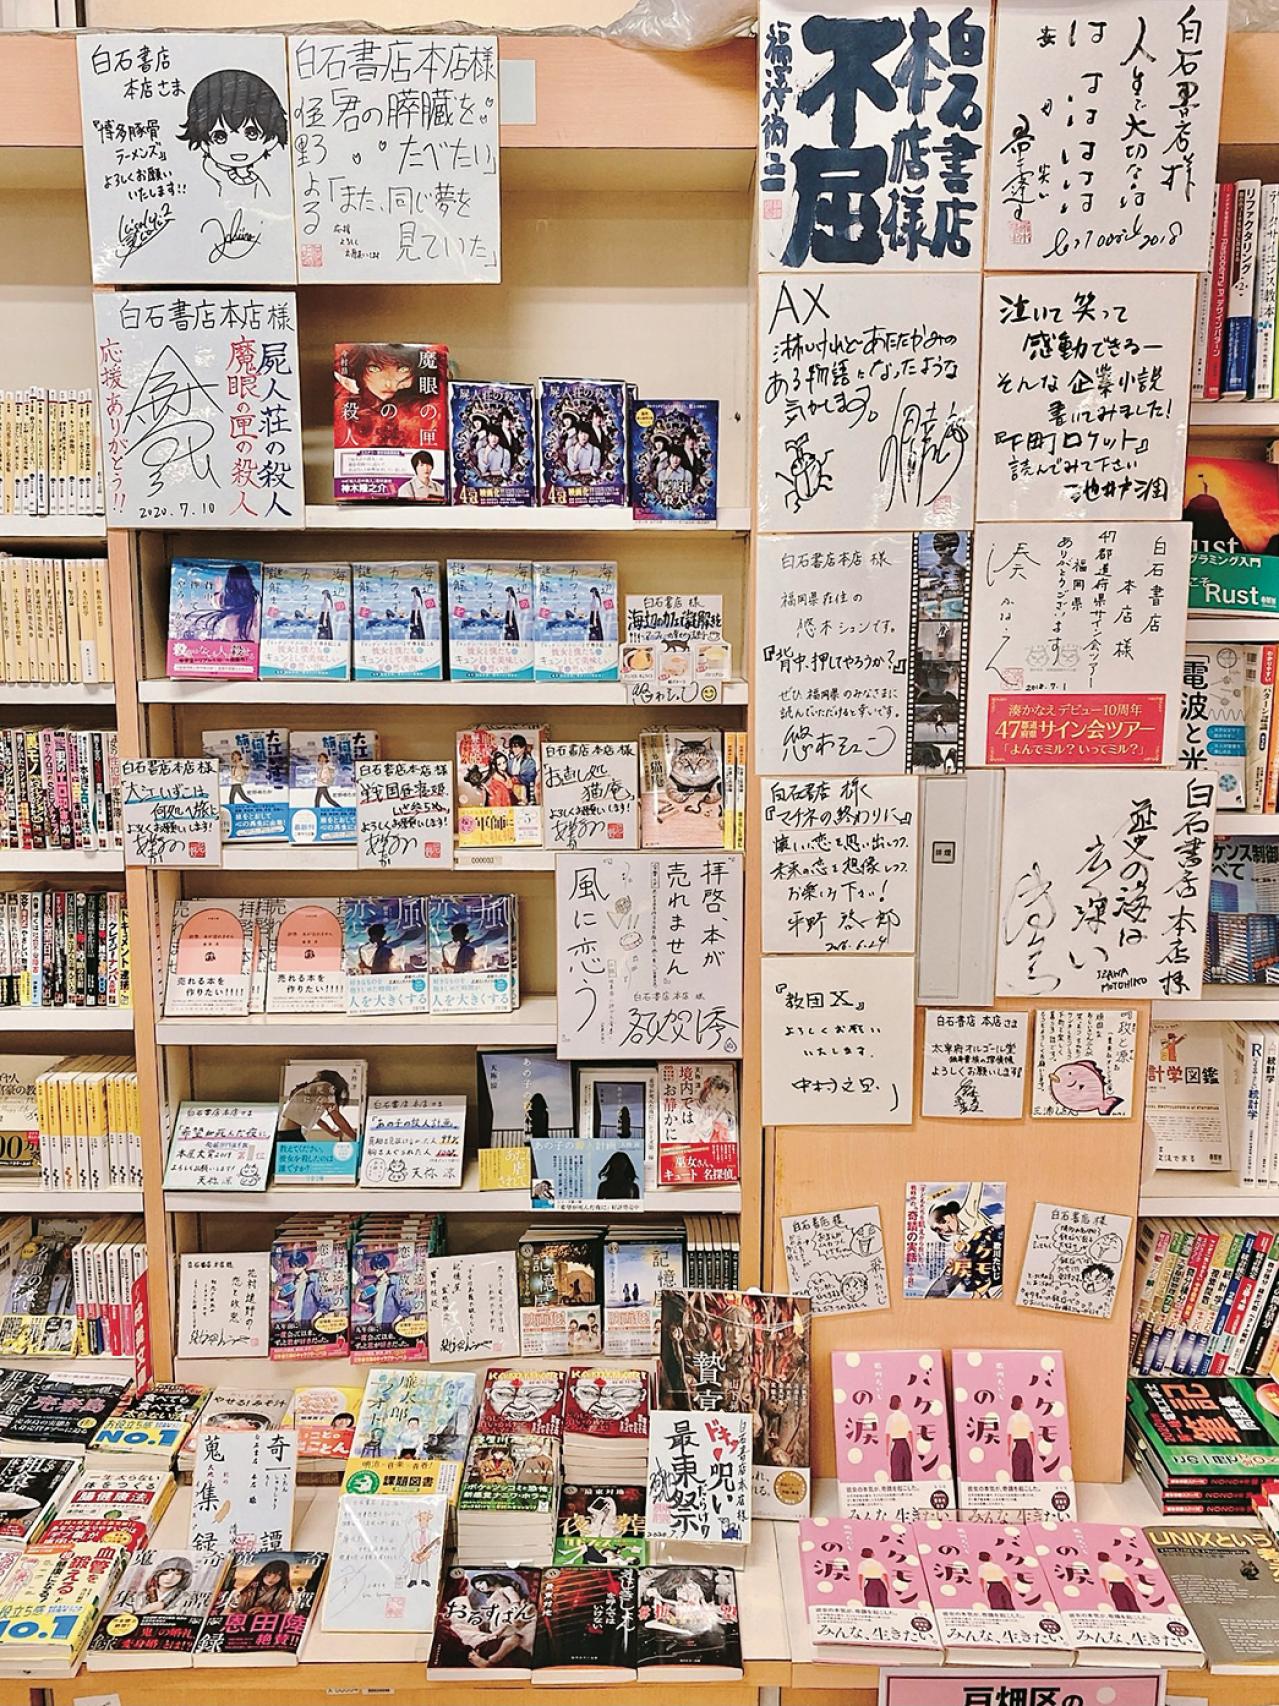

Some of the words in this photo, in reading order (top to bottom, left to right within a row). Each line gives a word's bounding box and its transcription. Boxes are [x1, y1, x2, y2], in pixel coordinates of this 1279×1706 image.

[91, 44, 172, 74] 白石書店
[295, 39, 498, 84] 白石書店本店様
[123, 76, 186, 99] 本店さま
[330, 87, 477, 133] 「君の膵臓を
[398, 133, 497, 177] たべたい」
[779, 15, 908, 267] 不屈
[396, 220, 497, 269] 見ていた」
[1240, 186, 1257, 275] リファクタリング
[119, 297, 296, 332] 白石書店本店様
[769, 280, 830, 335] AX
[998, 291, 1129, 325] 泣いて笑って
[418, 350, 439, 448] 魔眼の匣
[996, 363, 1167, 399] そんな企業小説
[225, 334, 263, 517] 魔眼の匣の殺人
[256, 341, 295, 518] 屍人荘の殺人
[341, 402, 360, 447] 殺人
[780, 550, 893, 571] 白石書店本店様
[1070, 558, 1089, 612] 福岡県
[1139, 535, 1168, 636] 白石書店
[780, 591, 864, 609] 福岡県在住の
[1204, 583, 1260, 606] Rust
[1112, 579, 1138, 662] 本店様
[1008, 703, 1057, 718] 湊かなえ
[1059, 703, 1143, 718] デビュー10周年
[122, 759, 218, 776] 白石書店本店様
[545, 744, 637, 759] 白石書店本店様
[764, 805, 913, 829] 『マチネの終わりに』
[1155, 777, 1215, 996] 白石書店本店様
[666, 861, 692, 976] 売れません
[700, 858, 730, 968] 拝啓、本が
[567, 866, 611, 1033] 風に恋う
[176, 976, 226, 988] 売れる本を
[276, 972, 326, 984] 売れる本を
[663, 1083, 679, 1142] お静かに
[678, 1065, 696, 1125] 境内では
[845, 1388, 879, 1445] の涙
[906, 1367, 940, 1473] バケモン
[966, 1388, 1001, 1445] の涙
[1028, 1369, 1061, 1474] バケモン
[663, 1419, 705, 1533] 最東祭
[706, 1461, 737, 1516] 呪い
[813, 1540, 852, 1582] の涙
[879, 1532, 919, 1606] バケモン
[932, 1543, 974, 1585] の涙
[994, 1533, 1042, 1607] バケモン
[1053, 1545, 1097, 1586] の涙
[1112, 1536, 1167, 1609] バケモン
[222, 1612, 307, 1634] 恩田陸
[442, 1598, 537, 1627] おるすばん
